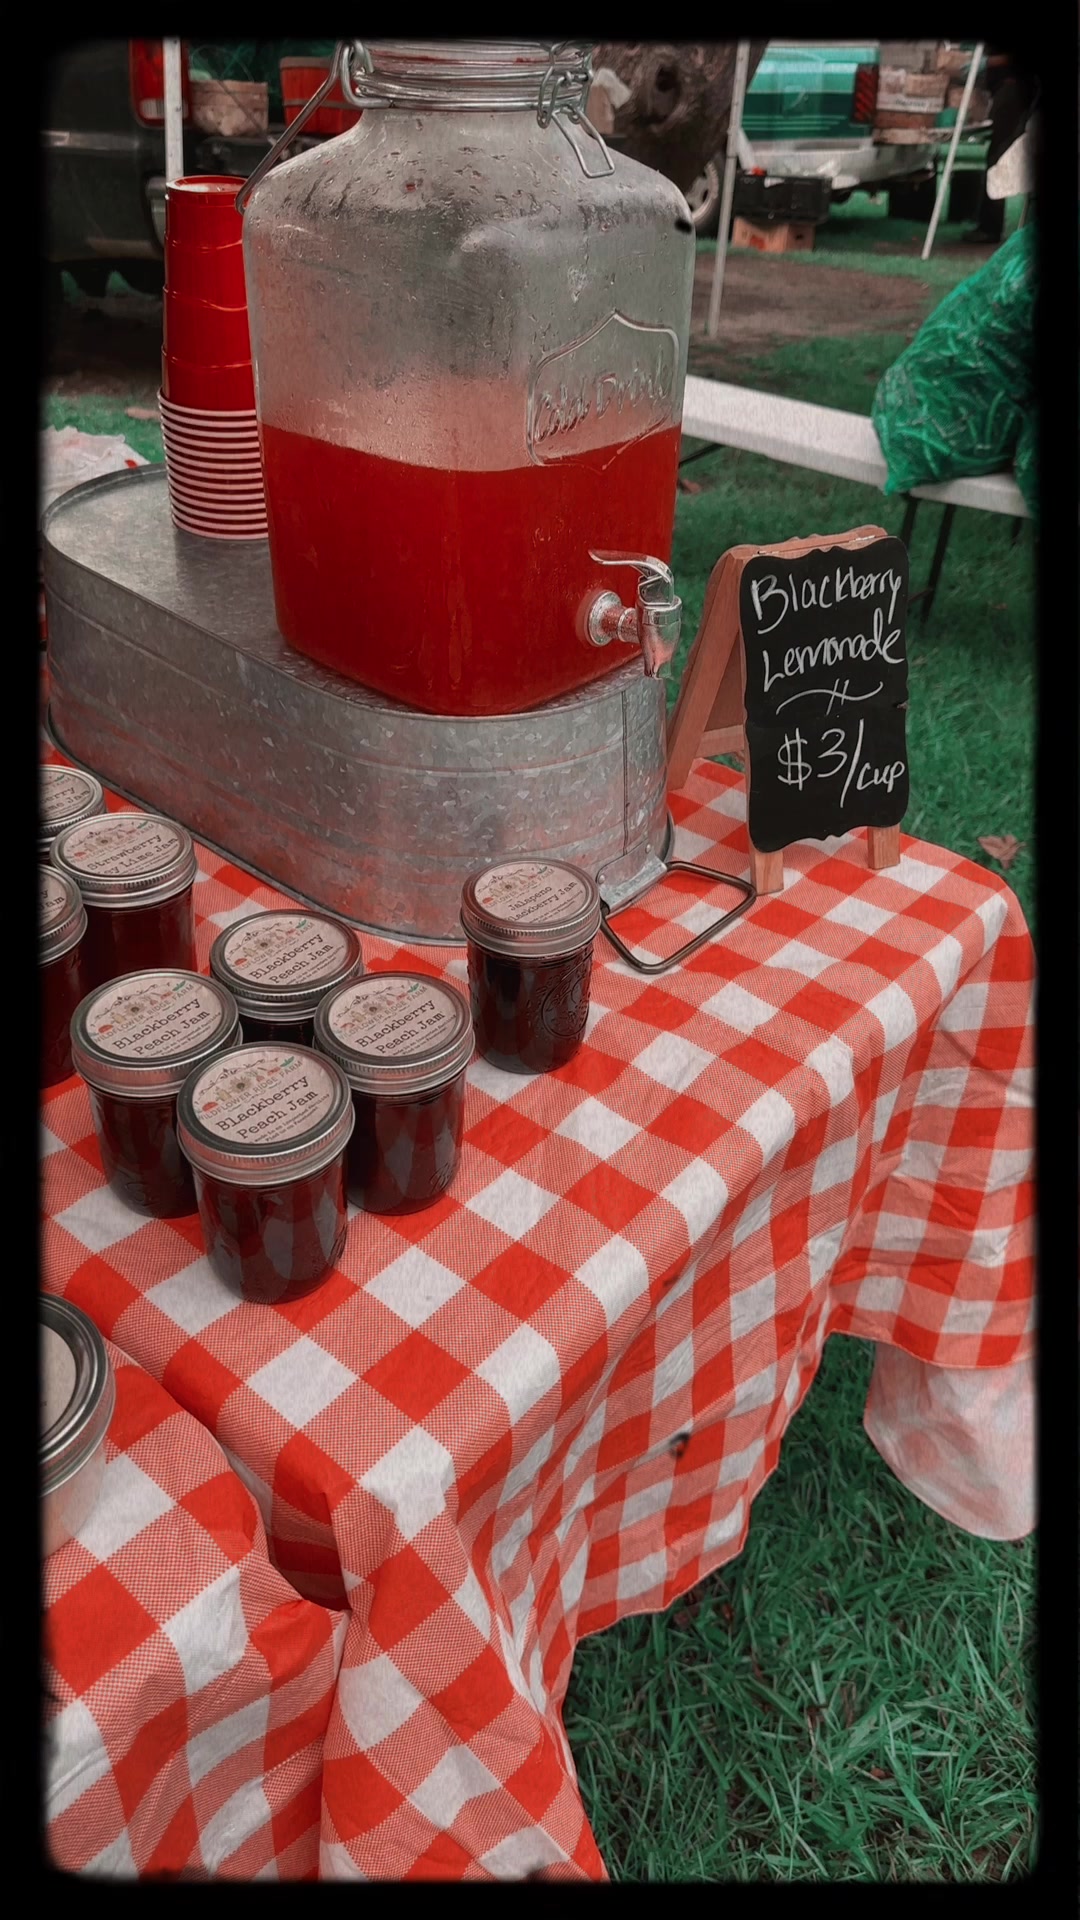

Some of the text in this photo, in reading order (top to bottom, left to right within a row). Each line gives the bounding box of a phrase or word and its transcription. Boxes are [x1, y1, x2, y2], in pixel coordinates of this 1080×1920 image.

[751, 565, 902, 635] Blackberry
[762, 607, 906, 693] Lemonade
[777, 718, 906, 808] $3/cup
[87, 834, 162, 870] Strawberry
[119, 851, 154, 868] Lime
[154, 838, 178, 852] Jam
[508, 886, 553, 911] Jalapeno
[558, 881, 578, 896] Jam
[249, 933, 324, 979] Blackberry
[269, 960, 310, 984] Peach
[308, 944, 334, 961] Jam
[172, 983, 195, 1001] FARM
[112, 998, 201, 1049] Blackberry
[132, 1028, 182, 1055] Peach
[180, 1010, 211, 1029] Jam
[354, 999, 436, 1049] Blackberry
[375, 1028, 420, 1054] Peach
[417, 1012, 446, 1030] Jam
[252, 1076, 279, 1094] RIDGE
[279, 1059, 303, 1079] FARM
[215, 1075, 310, 1131] Blackberry
[236, 1110, 288, 1139] Peach
[287, 1091, 319, 1111] Jam
